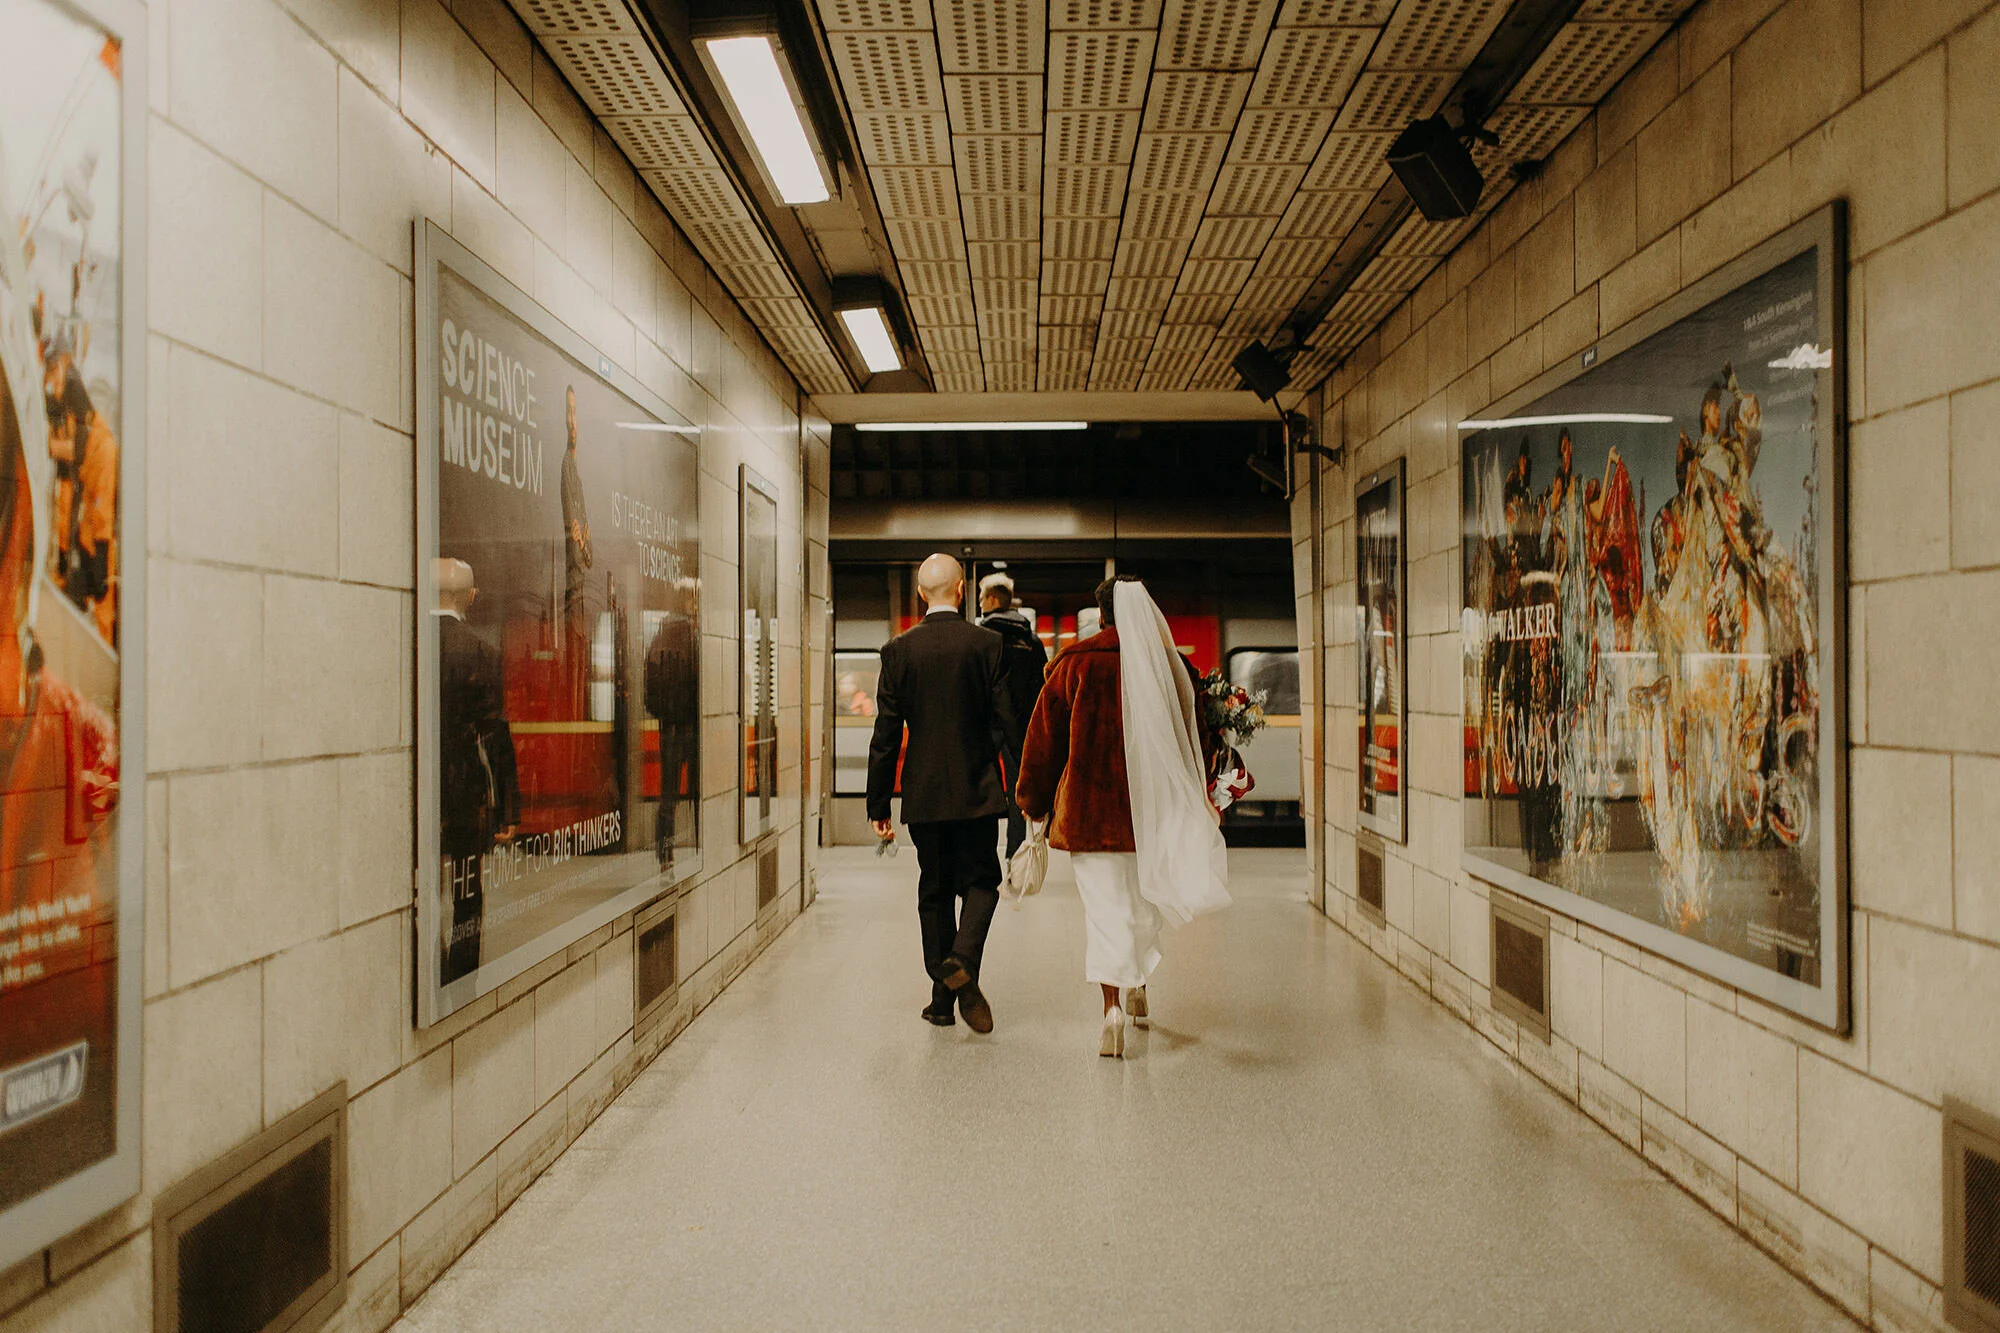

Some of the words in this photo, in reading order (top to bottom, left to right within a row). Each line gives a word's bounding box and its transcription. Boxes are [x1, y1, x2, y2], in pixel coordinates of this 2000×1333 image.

[442, 318, 537, 429] SCIENCE
[444, 395, 543, 496] MUSEUM
[612, 489, 620, 528] IS
[623, 495, 651, 539] THERE
[654, 510, 666, 545] AN
[666, 512, 679, 550] ART
[638, 541, 650, 577] TO
[1496, 602, 1558, 643] WALKER
[444, 854, 476, 905] THE
[482, 839, 522, 890] HOME
[526, 832, 551, 876] FOR
[553, 825, 571, 866] BIG
[573, 809, 621, 857] THINKERS
